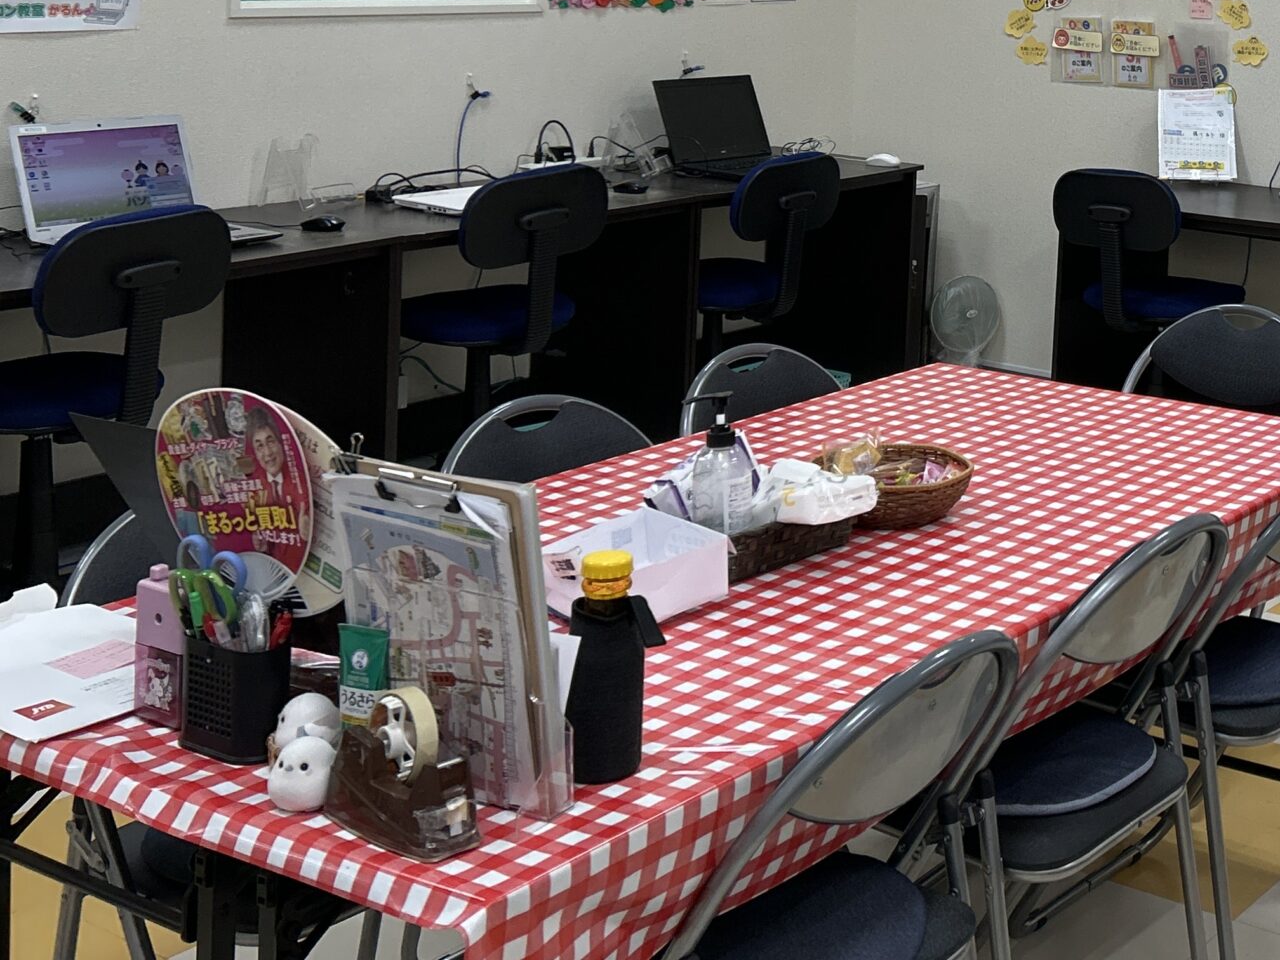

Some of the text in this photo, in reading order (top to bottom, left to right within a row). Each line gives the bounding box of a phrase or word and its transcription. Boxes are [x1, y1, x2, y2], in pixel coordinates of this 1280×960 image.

[0, 3, 45, 18] ン教室
[341, 690, 375, 709] うるさら
